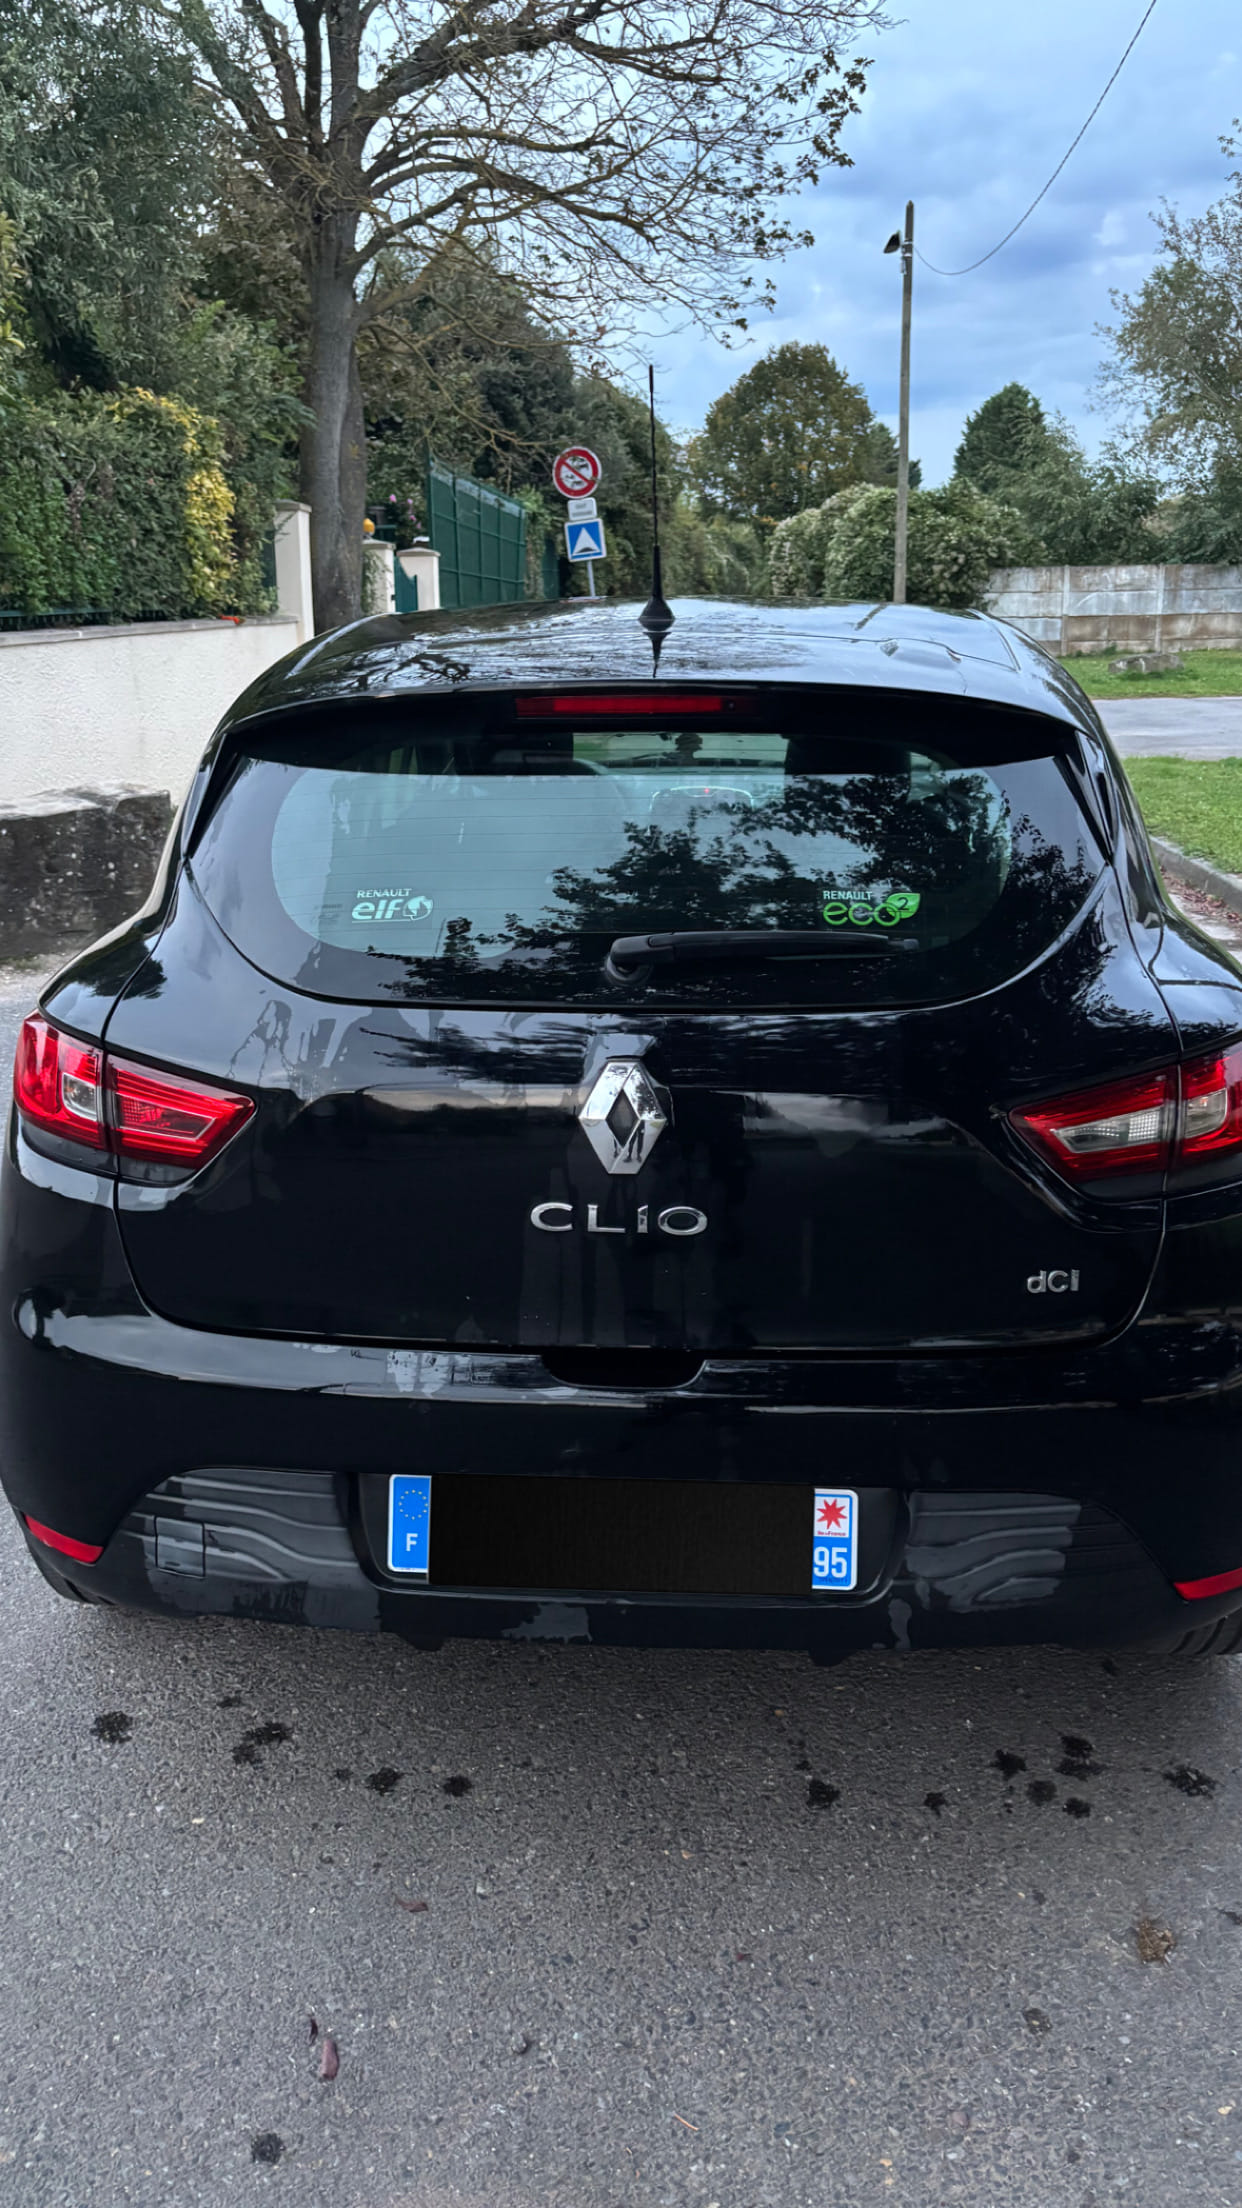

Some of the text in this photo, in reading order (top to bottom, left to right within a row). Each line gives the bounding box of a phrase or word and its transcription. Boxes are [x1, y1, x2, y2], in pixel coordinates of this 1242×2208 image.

[356, 888, 412, 898] RENAULT
[823, 890, 872, 900] RENAULT
[351, 899, 404, 920] elf
[530, 1202, 708, 1236] CLIO
[405, 1533, 418, 1552] F
[813, 1546, 848, 1578] 95
